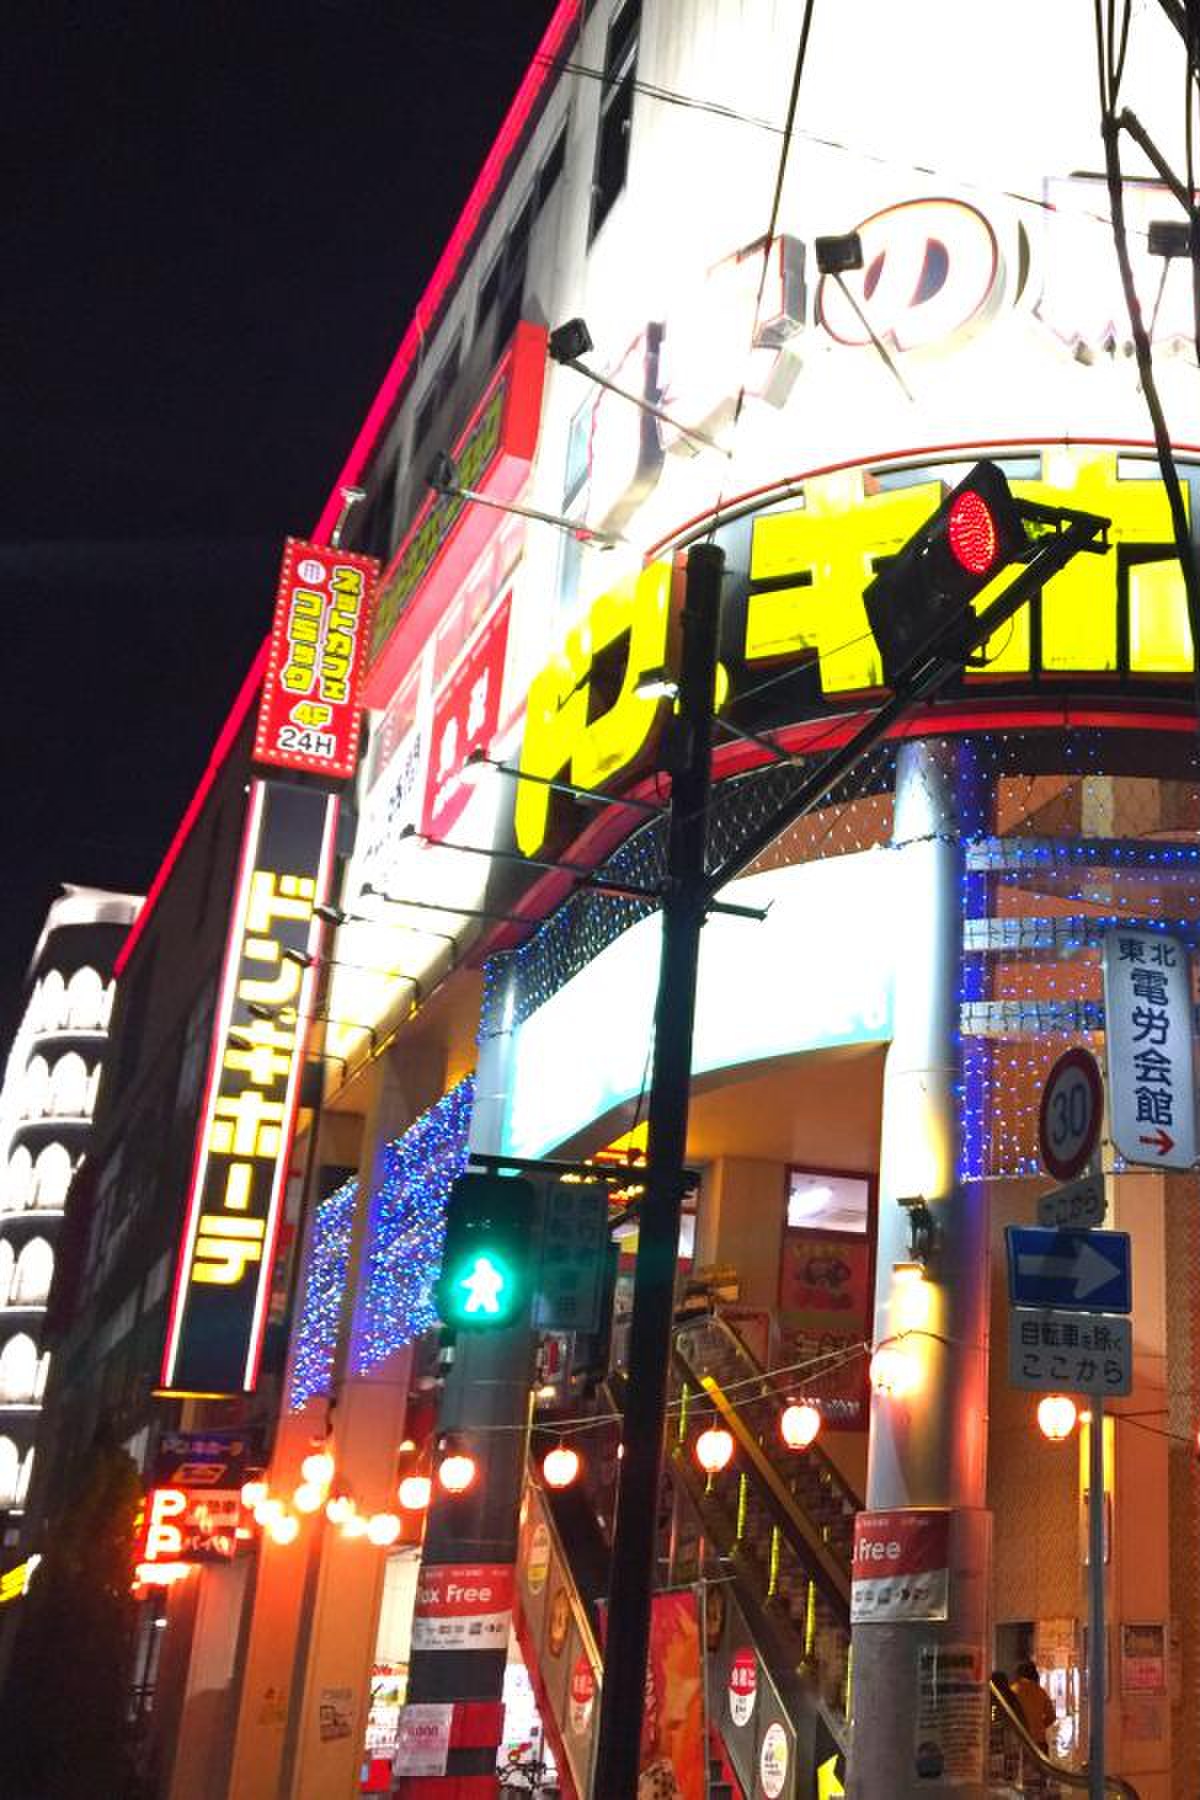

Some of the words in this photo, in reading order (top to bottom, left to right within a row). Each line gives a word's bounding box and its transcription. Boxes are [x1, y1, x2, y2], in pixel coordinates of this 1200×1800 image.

[291, 703, 331, 728] 4F
[279, 728, 335, 756] 24H
[1119, 937, 1177, 967] 東北
[1130, 967, 1174, 1127] 電労会館
[1052, 1084, 1087, 1147] 30
[1023, 1354, 1122, 1384] ここから
